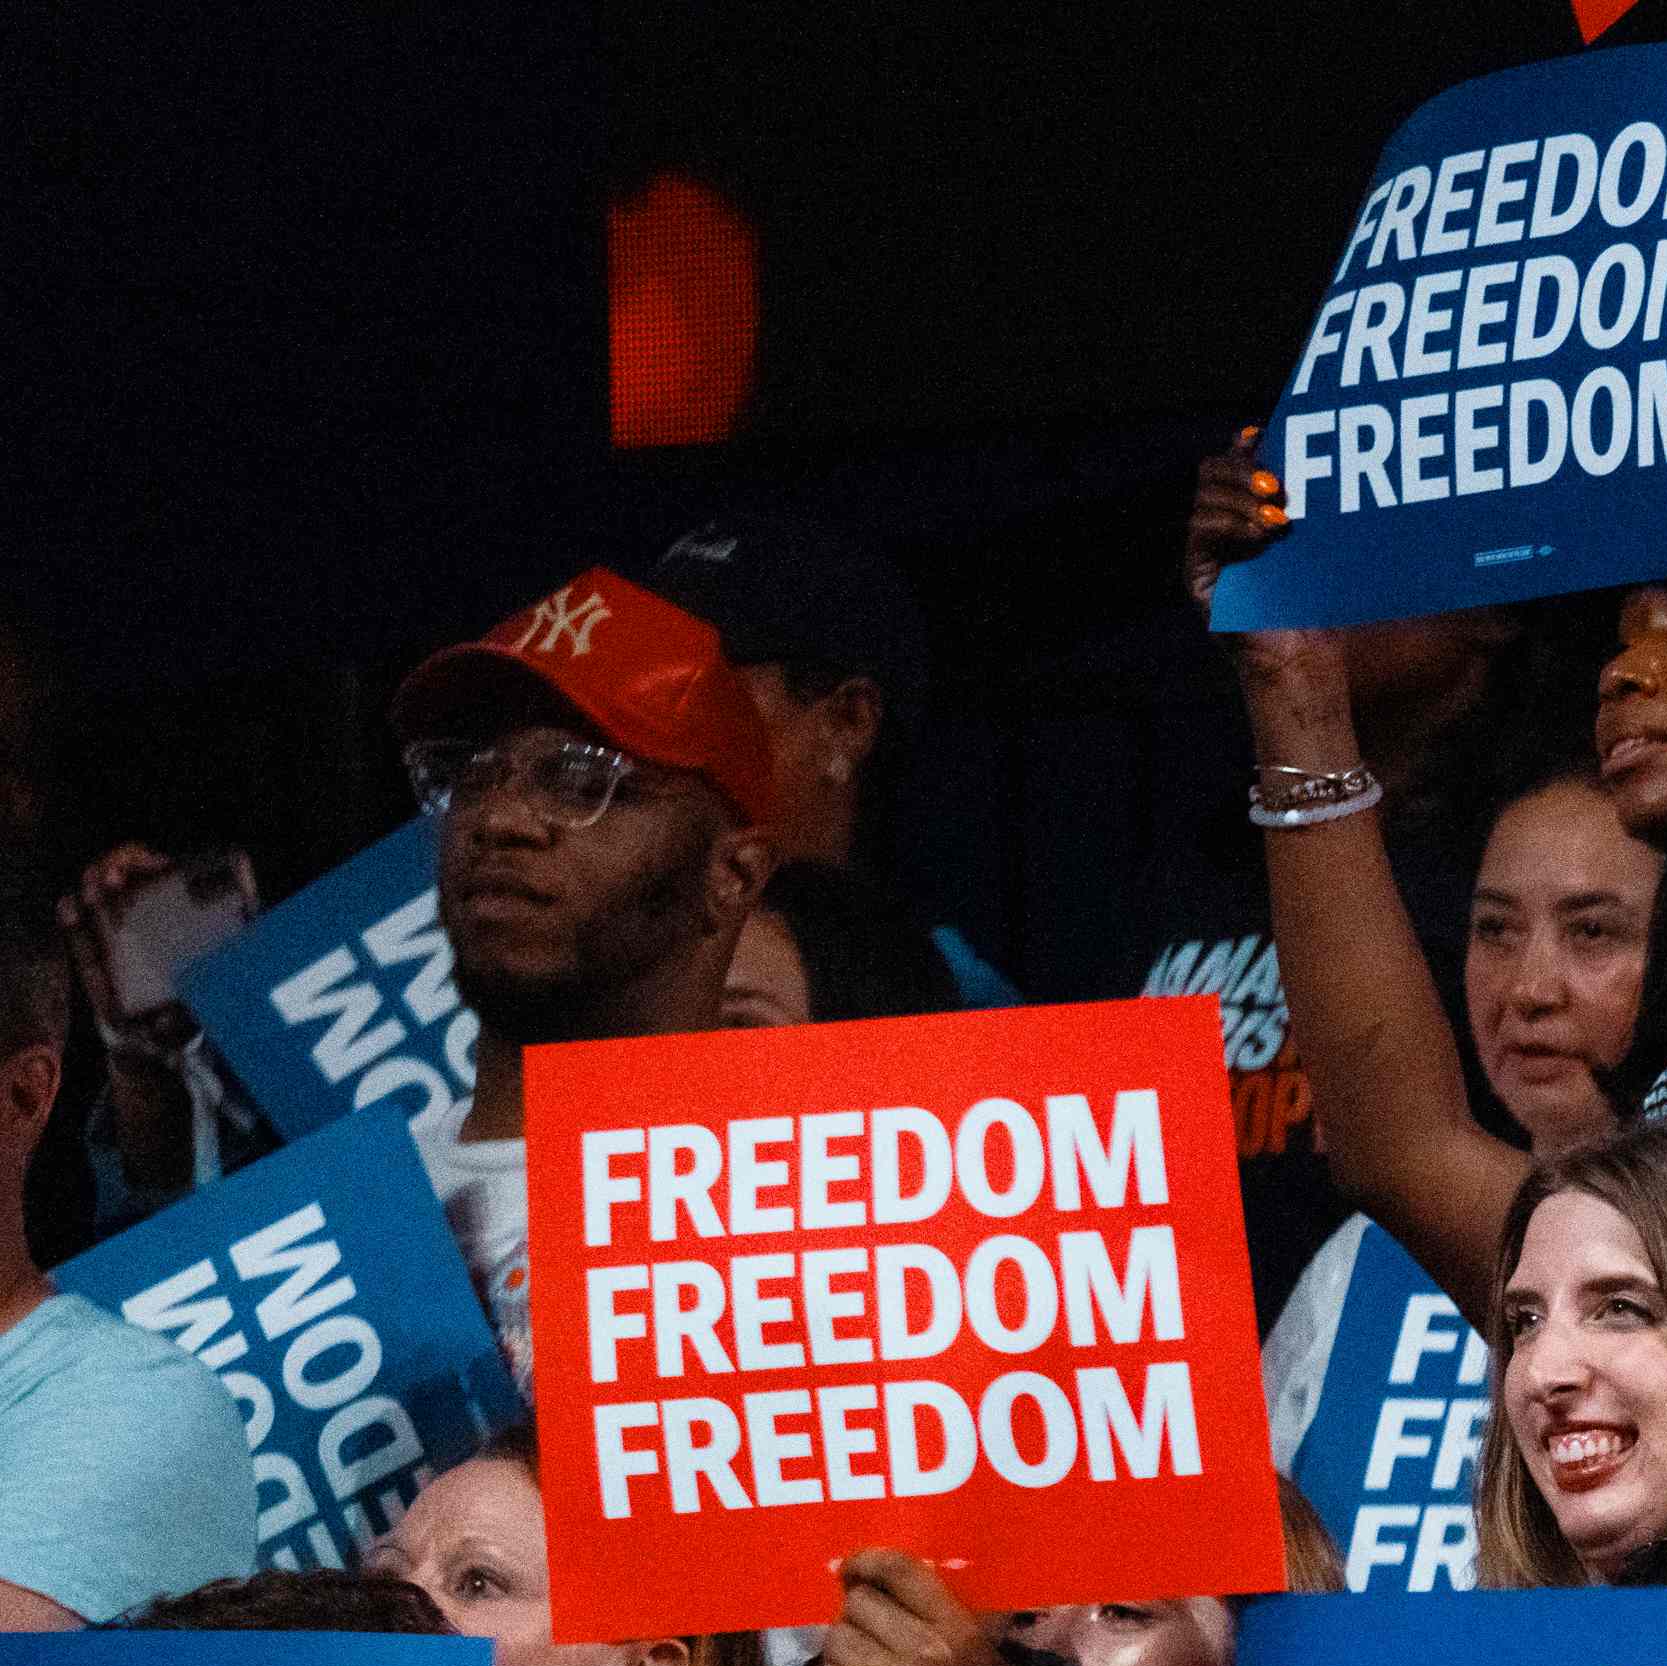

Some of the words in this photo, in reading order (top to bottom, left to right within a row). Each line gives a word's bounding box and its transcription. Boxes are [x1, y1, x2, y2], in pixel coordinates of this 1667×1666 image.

[582, 1090, 1170, 1247] FREEDOM
[586, 1226, 1185, 1383] FREEDOM
[594, 1361, 1203, 1519] FREEDOM
